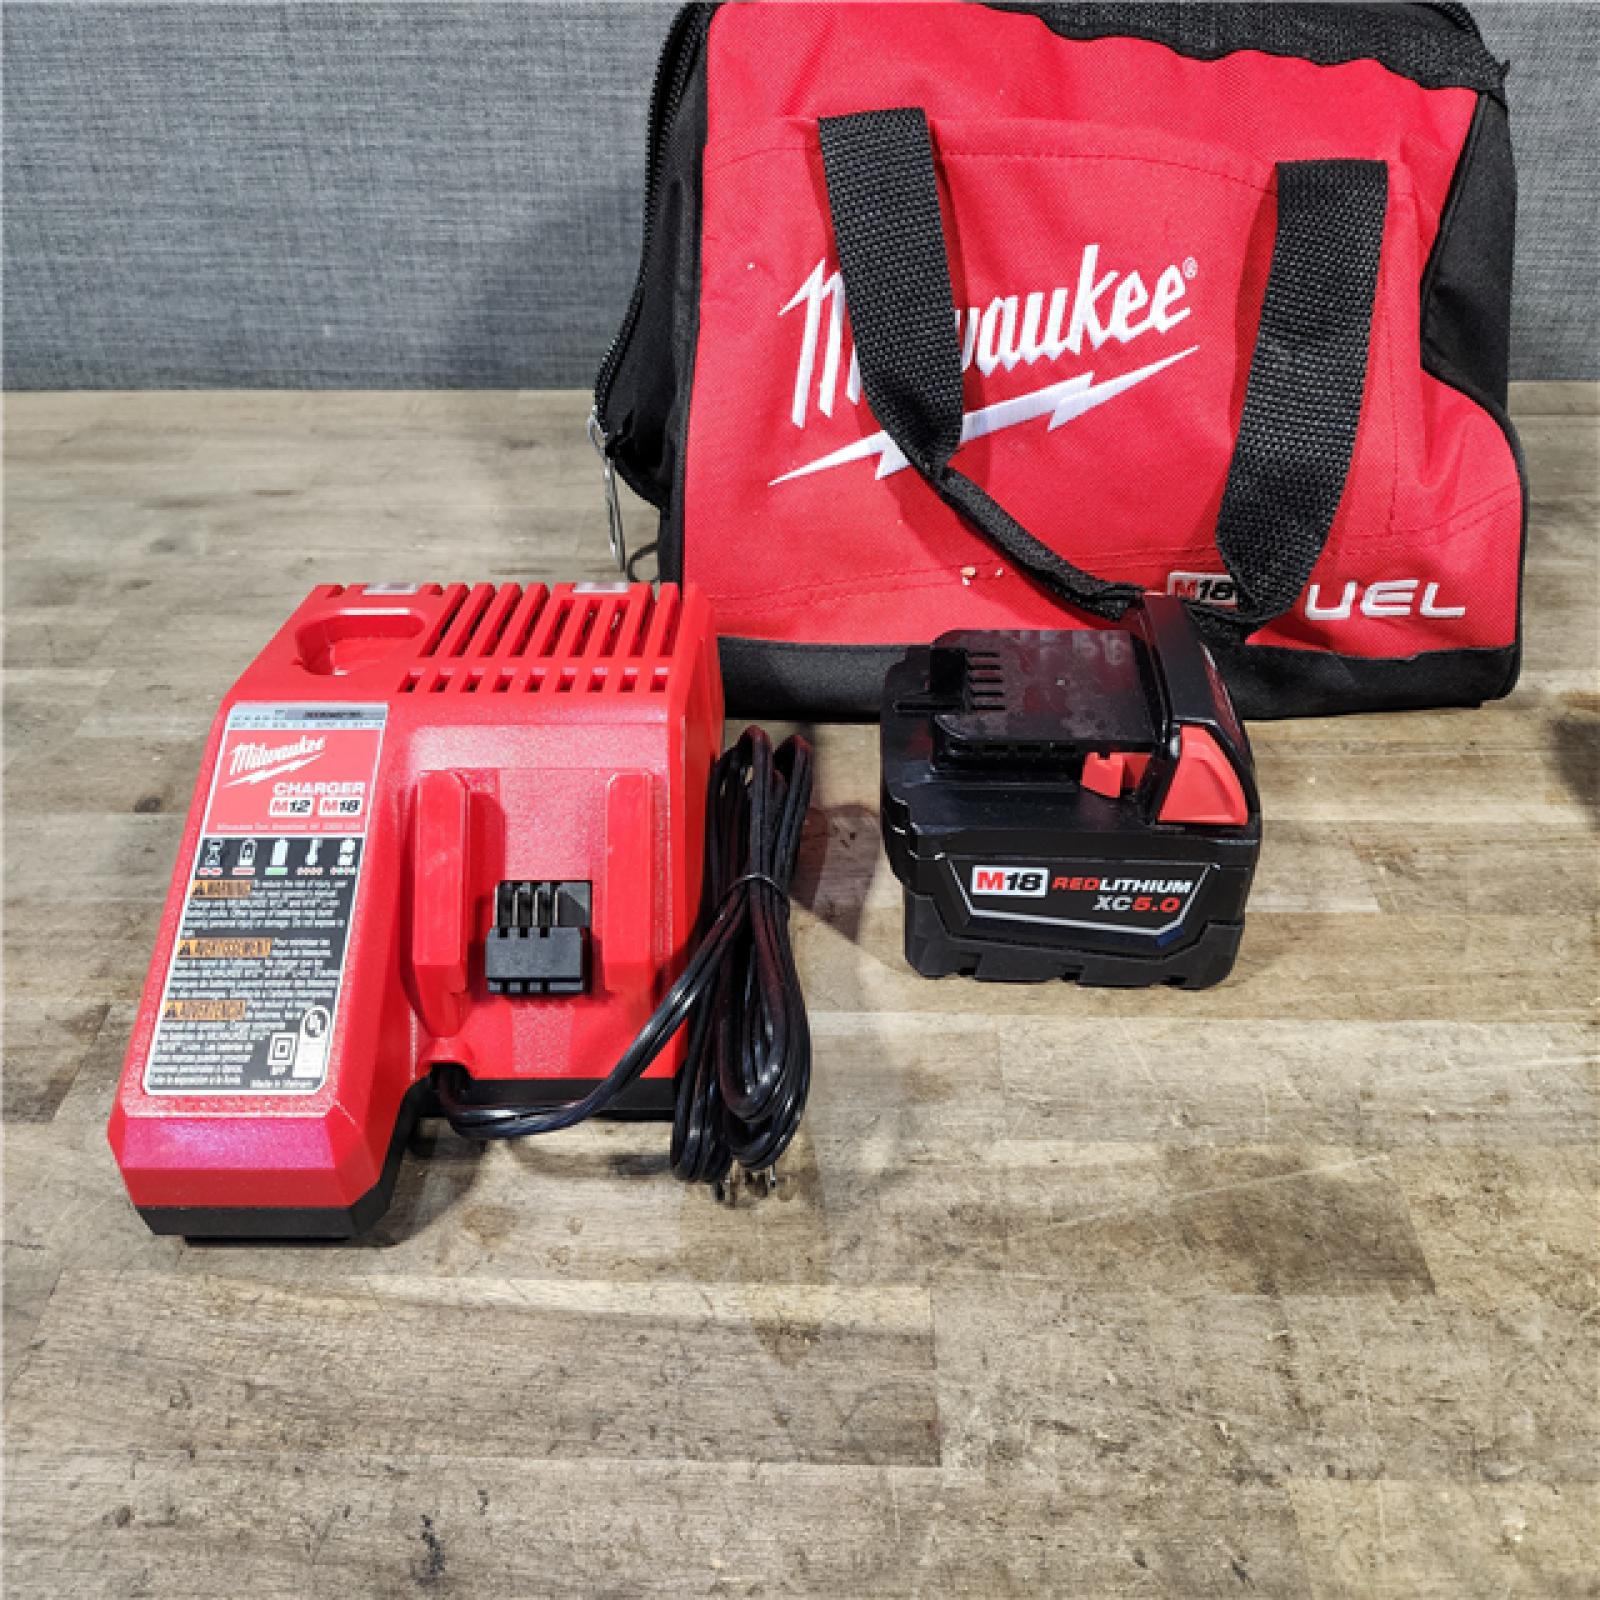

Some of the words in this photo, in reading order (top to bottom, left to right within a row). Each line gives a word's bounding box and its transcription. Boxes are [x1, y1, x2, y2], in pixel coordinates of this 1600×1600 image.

[778, 244, 1192, 429] Maukee
[1305, 579, 1466, 621] UEL
[272, 781, 366, 797] CHARGER
[270, 798, 311, 814] M12
[320, 798, 362, 814] M18
[974, 869, 1046, 894] M18
[1052, 876, 1193, 894] REDLITHIUM
[1092, 894, 1181, 913] XC5.0
